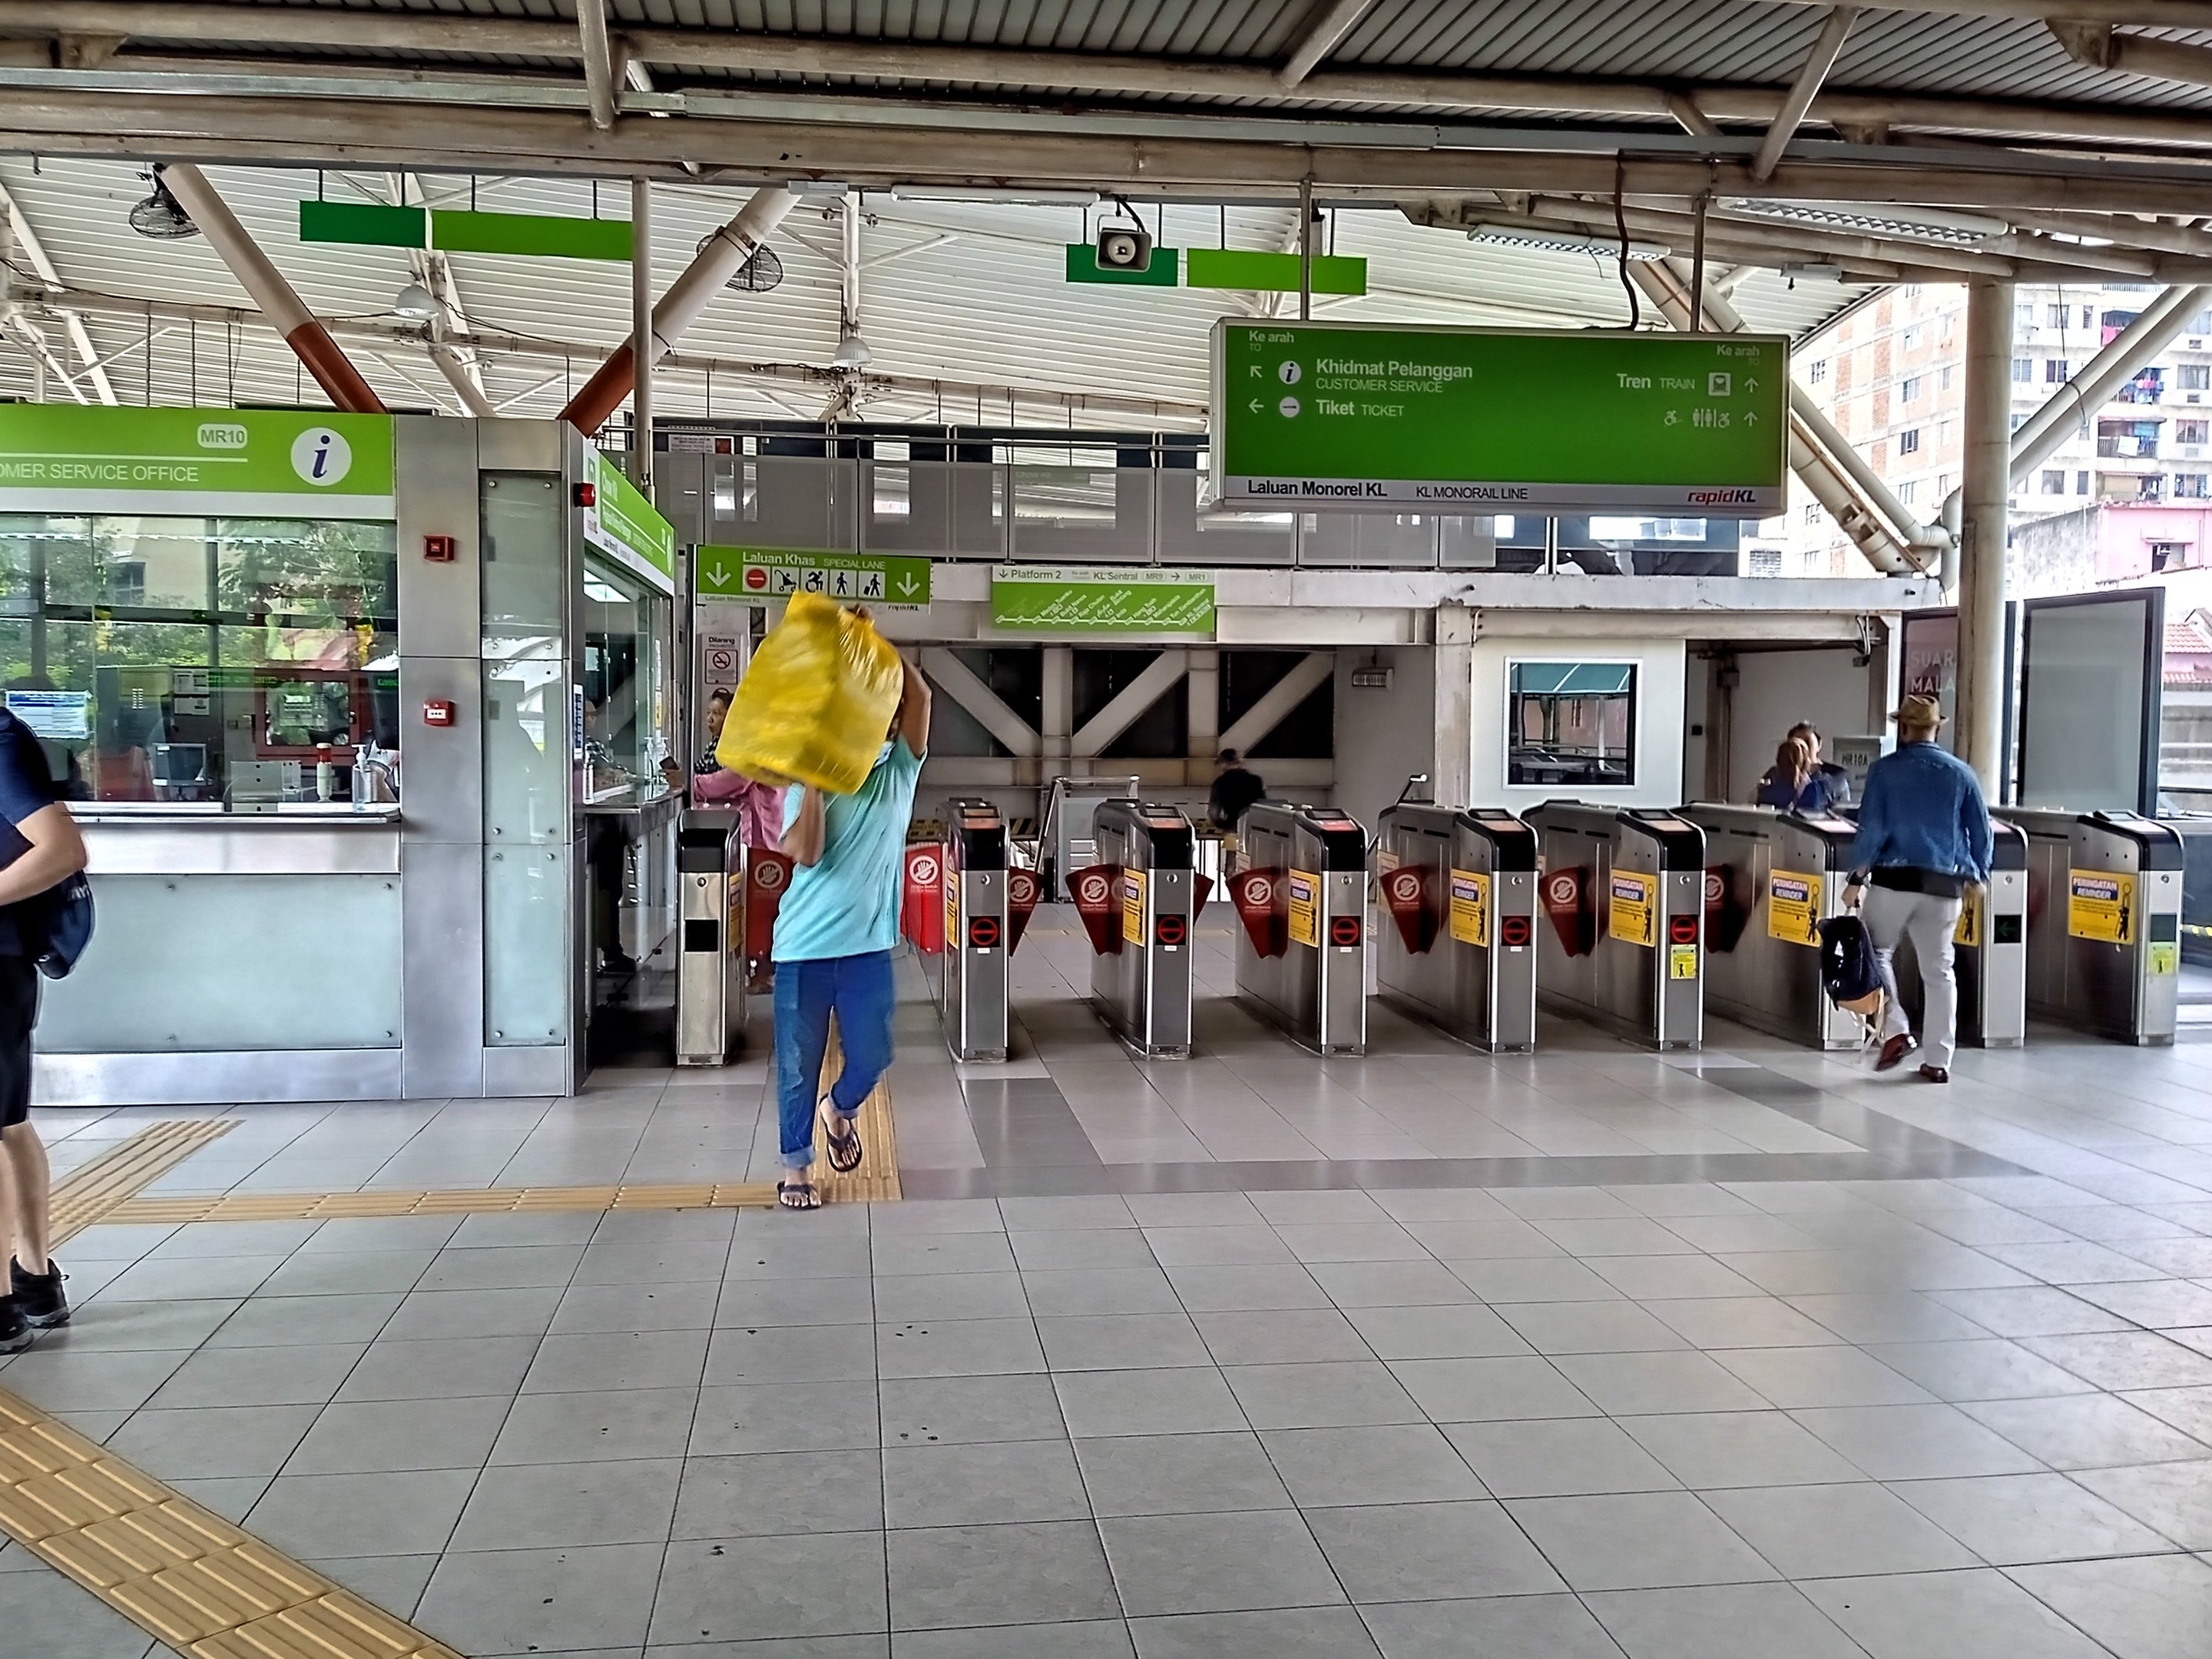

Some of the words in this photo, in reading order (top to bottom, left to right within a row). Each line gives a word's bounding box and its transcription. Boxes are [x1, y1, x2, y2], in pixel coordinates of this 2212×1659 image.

[1249, 330, 1266, 343] Ke
[1268, 332, 1294, 343] arah
[1250, 343, 1262, 352] TO
[1717, 345, 1733, 356] Ke
[1734, 346, 1760, 357] arah
[1316, 359, 1385, 376] Khidmat
[1388, 361, 1473, 381] Pelanggan
[1316, 378, 1387, 392] CUSTOMER
[1389, 380, 1443, 393] SERVICE
[1617, 373, 1651, 389] Tren
[1660, 378, 1696, 389] TRAIN
[1316, 399, 1355, 416] Tiket
[1361, 404, 1405, 417] TICKET
[200, 429, 245, 444] MR10
[0, 463, 45, 479] MER
[50, 464, 129, 481] SERVICE
[133, 465, 200, 482] OFFICE
[1248, 479, 1298, 495] Laluan
[1302, 482, 1363, 497] Monorel
[1366, 483, 1388, 497] KL
[1416, 486, 1432, 498] KL
[1433, 487, 1498, 499] MONORAIL
[1501, 488, 1528, 499] LINE
[1687, 490, 1757, 505] rapidKL
[742, 551, 782, 565] Laluan
[785, 554, 816, 566] Khas
[823, 558, 861, 569] SPECIAL
[862, 560, 886, 570] LANE
[1012, 570, 1053, 579] Platform
[1055, 571, 1061, 579] 2
[1094, 571, 1105, 580] KL
[1108, 571, 1138, 581] Sentral
[1145, 572, 1163, 581] MR9
